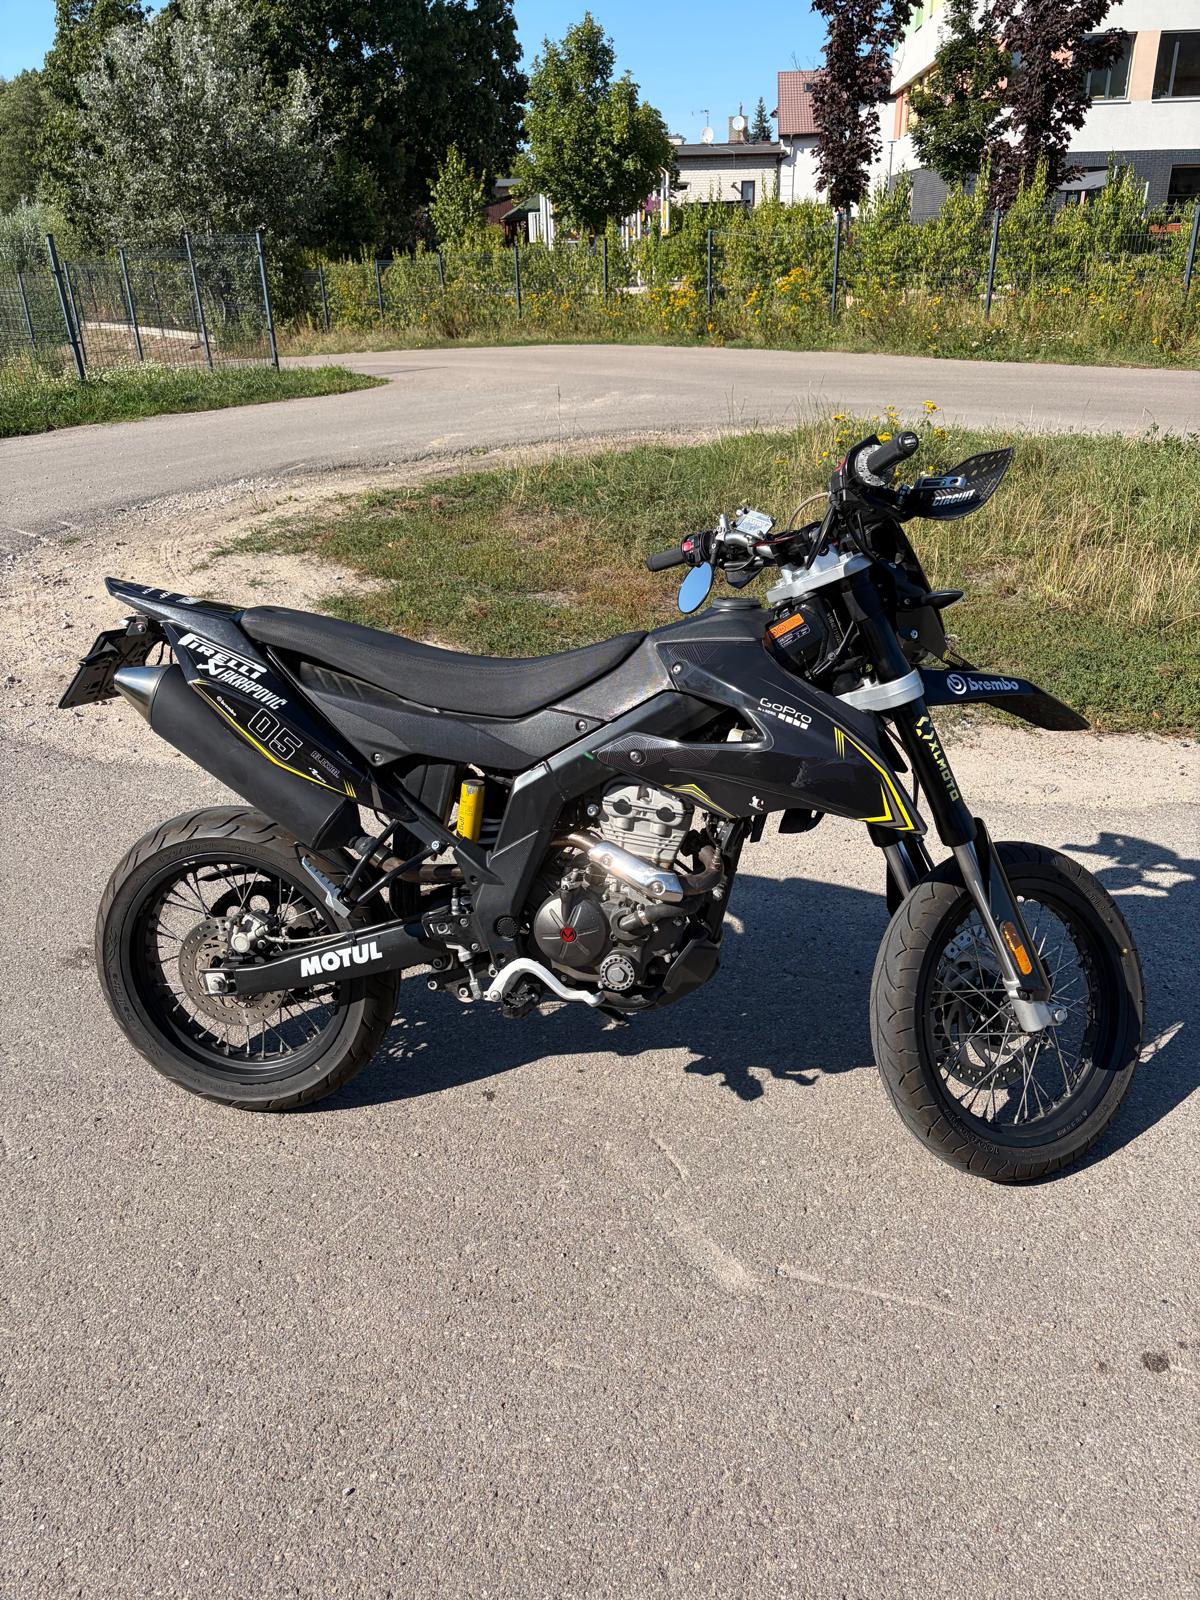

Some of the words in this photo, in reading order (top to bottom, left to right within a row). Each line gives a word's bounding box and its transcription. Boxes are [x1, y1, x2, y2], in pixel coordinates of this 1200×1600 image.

[932, 489, 976, 507] CIRCUIT
[178, 632, 267, 679] PIRELLI
[967, 677, 1019, 691] brembo
[760, 697, 812, 724] GoPro
[248, 707, 304, 761] 05
[928, 739, 960, 802] XLMOTO
[300, 941, 383, 978] MOTUL
